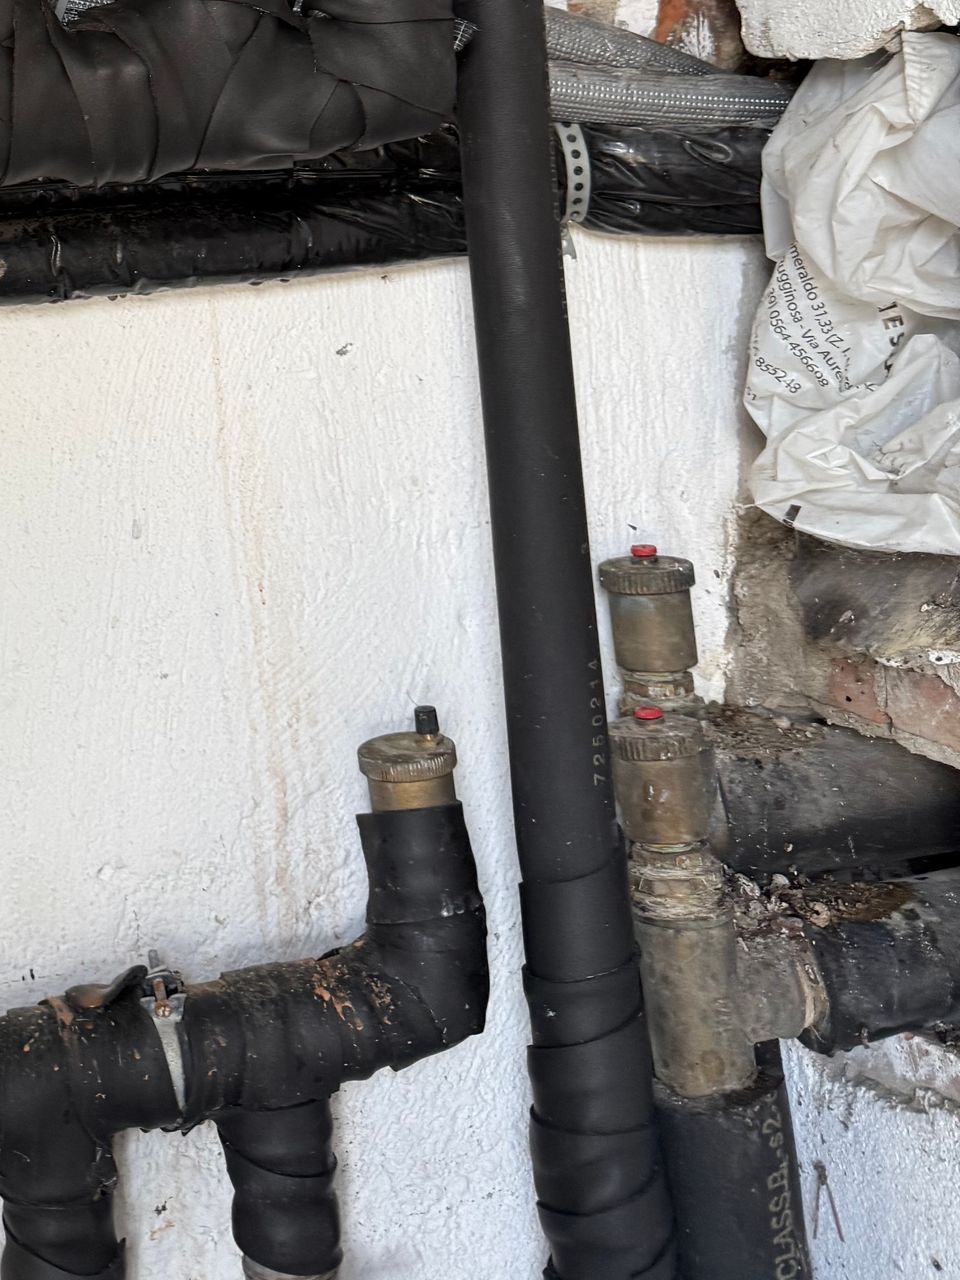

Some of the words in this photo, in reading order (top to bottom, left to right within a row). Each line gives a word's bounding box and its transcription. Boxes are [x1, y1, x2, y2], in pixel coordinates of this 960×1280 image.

[769, 309, 792, 341] 0564
[788, 341, 829, 387] 456608
[801, 328, 820, 349] Via
[755, 356, 802, 394] 855248
